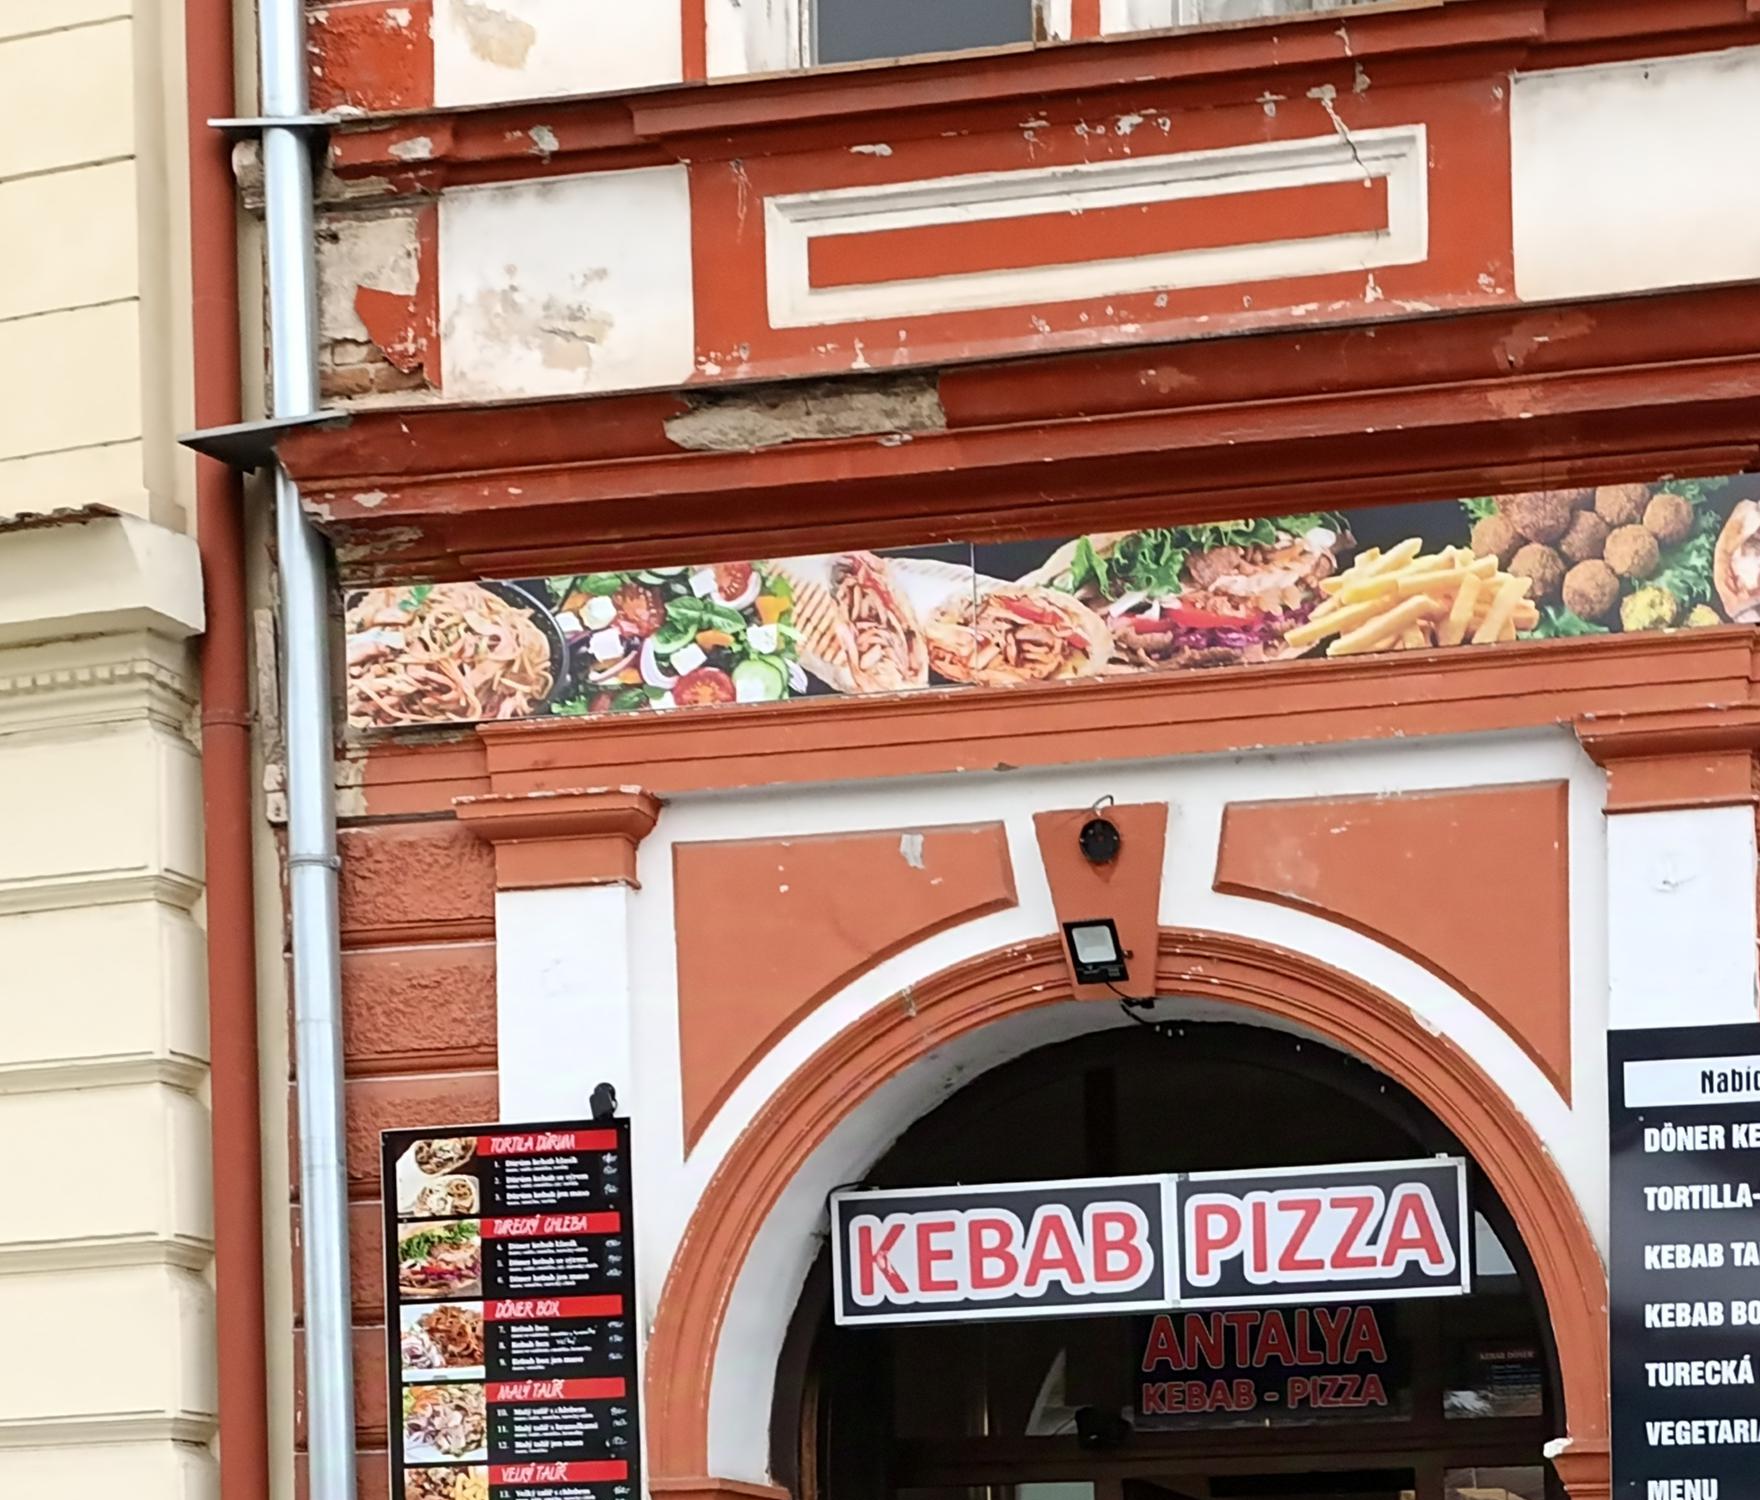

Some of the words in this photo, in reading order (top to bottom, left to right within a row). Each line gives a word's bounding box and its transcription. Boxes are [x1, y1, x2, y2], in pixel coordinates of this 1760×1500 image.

[1644, 1122, 1725, 1152] DÖNER
[853, 1207, 1149, 1301] KEBAB
[1189, 1188, 1451, 1282] PIZZA
[1645, 1243, 1724, 1269] KEBAB
[536, 1300, 560, 1317] BOX
[1645, 1301, 1724, 1328] KEBAB
[1141, 1306, 1388, 1372] ANTALYA
[1645, 1354, 1754, 1387] TURECKÁ
[1142, 1377, 1256, 1415] KEBAB
[1287, 1374, 1389, 1410] PIZZA
